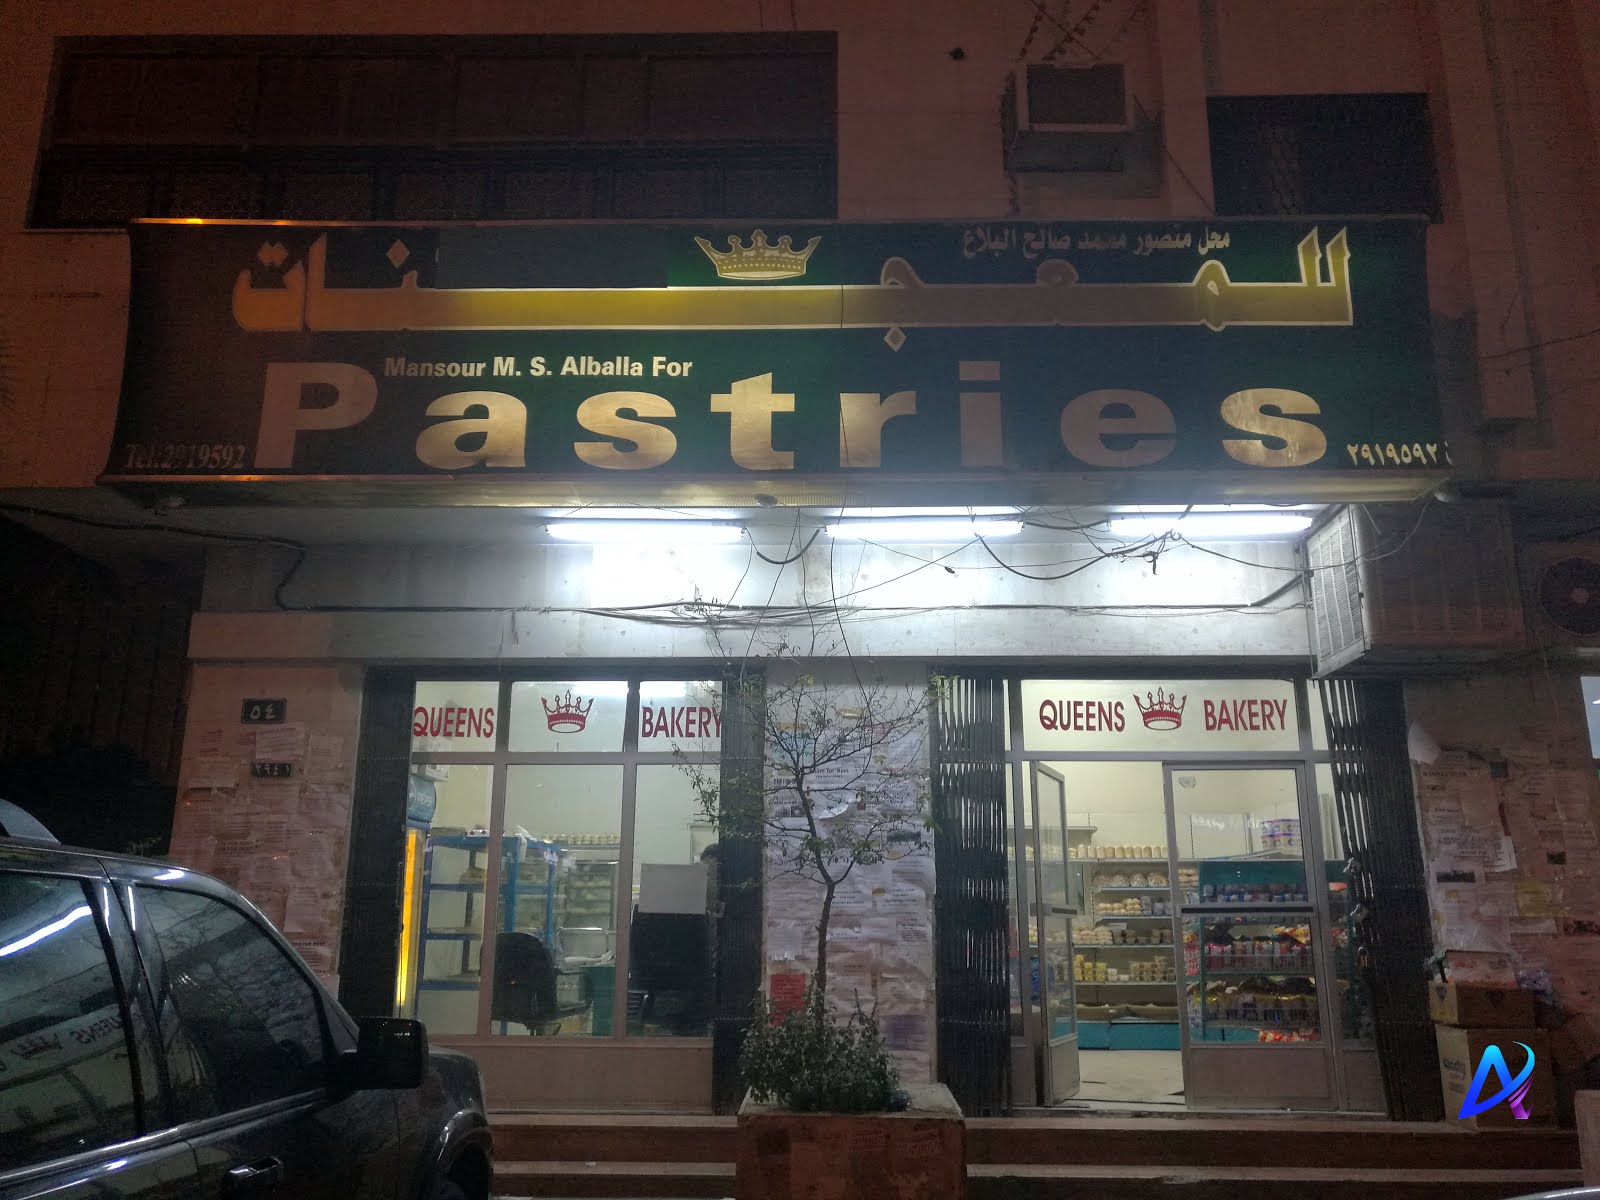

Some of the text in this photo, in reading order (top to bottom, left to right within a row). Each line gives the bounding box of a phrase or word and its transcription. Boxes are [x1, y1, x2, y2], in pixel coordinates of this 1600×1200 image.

[1024, 226, 1071, 258] صالح
[1134, 224, 1192, 255] منصور
[1198, 225, 1230, 255] محل
[384, 356, 693, 377] Mansour M. S. Alballa For
[254, 360, 1328, 471] Pastries
[413, 706, 723, 738] QUEENS BAKERY
[1039, 698, 1288, 732] QUEENS BAKERY
